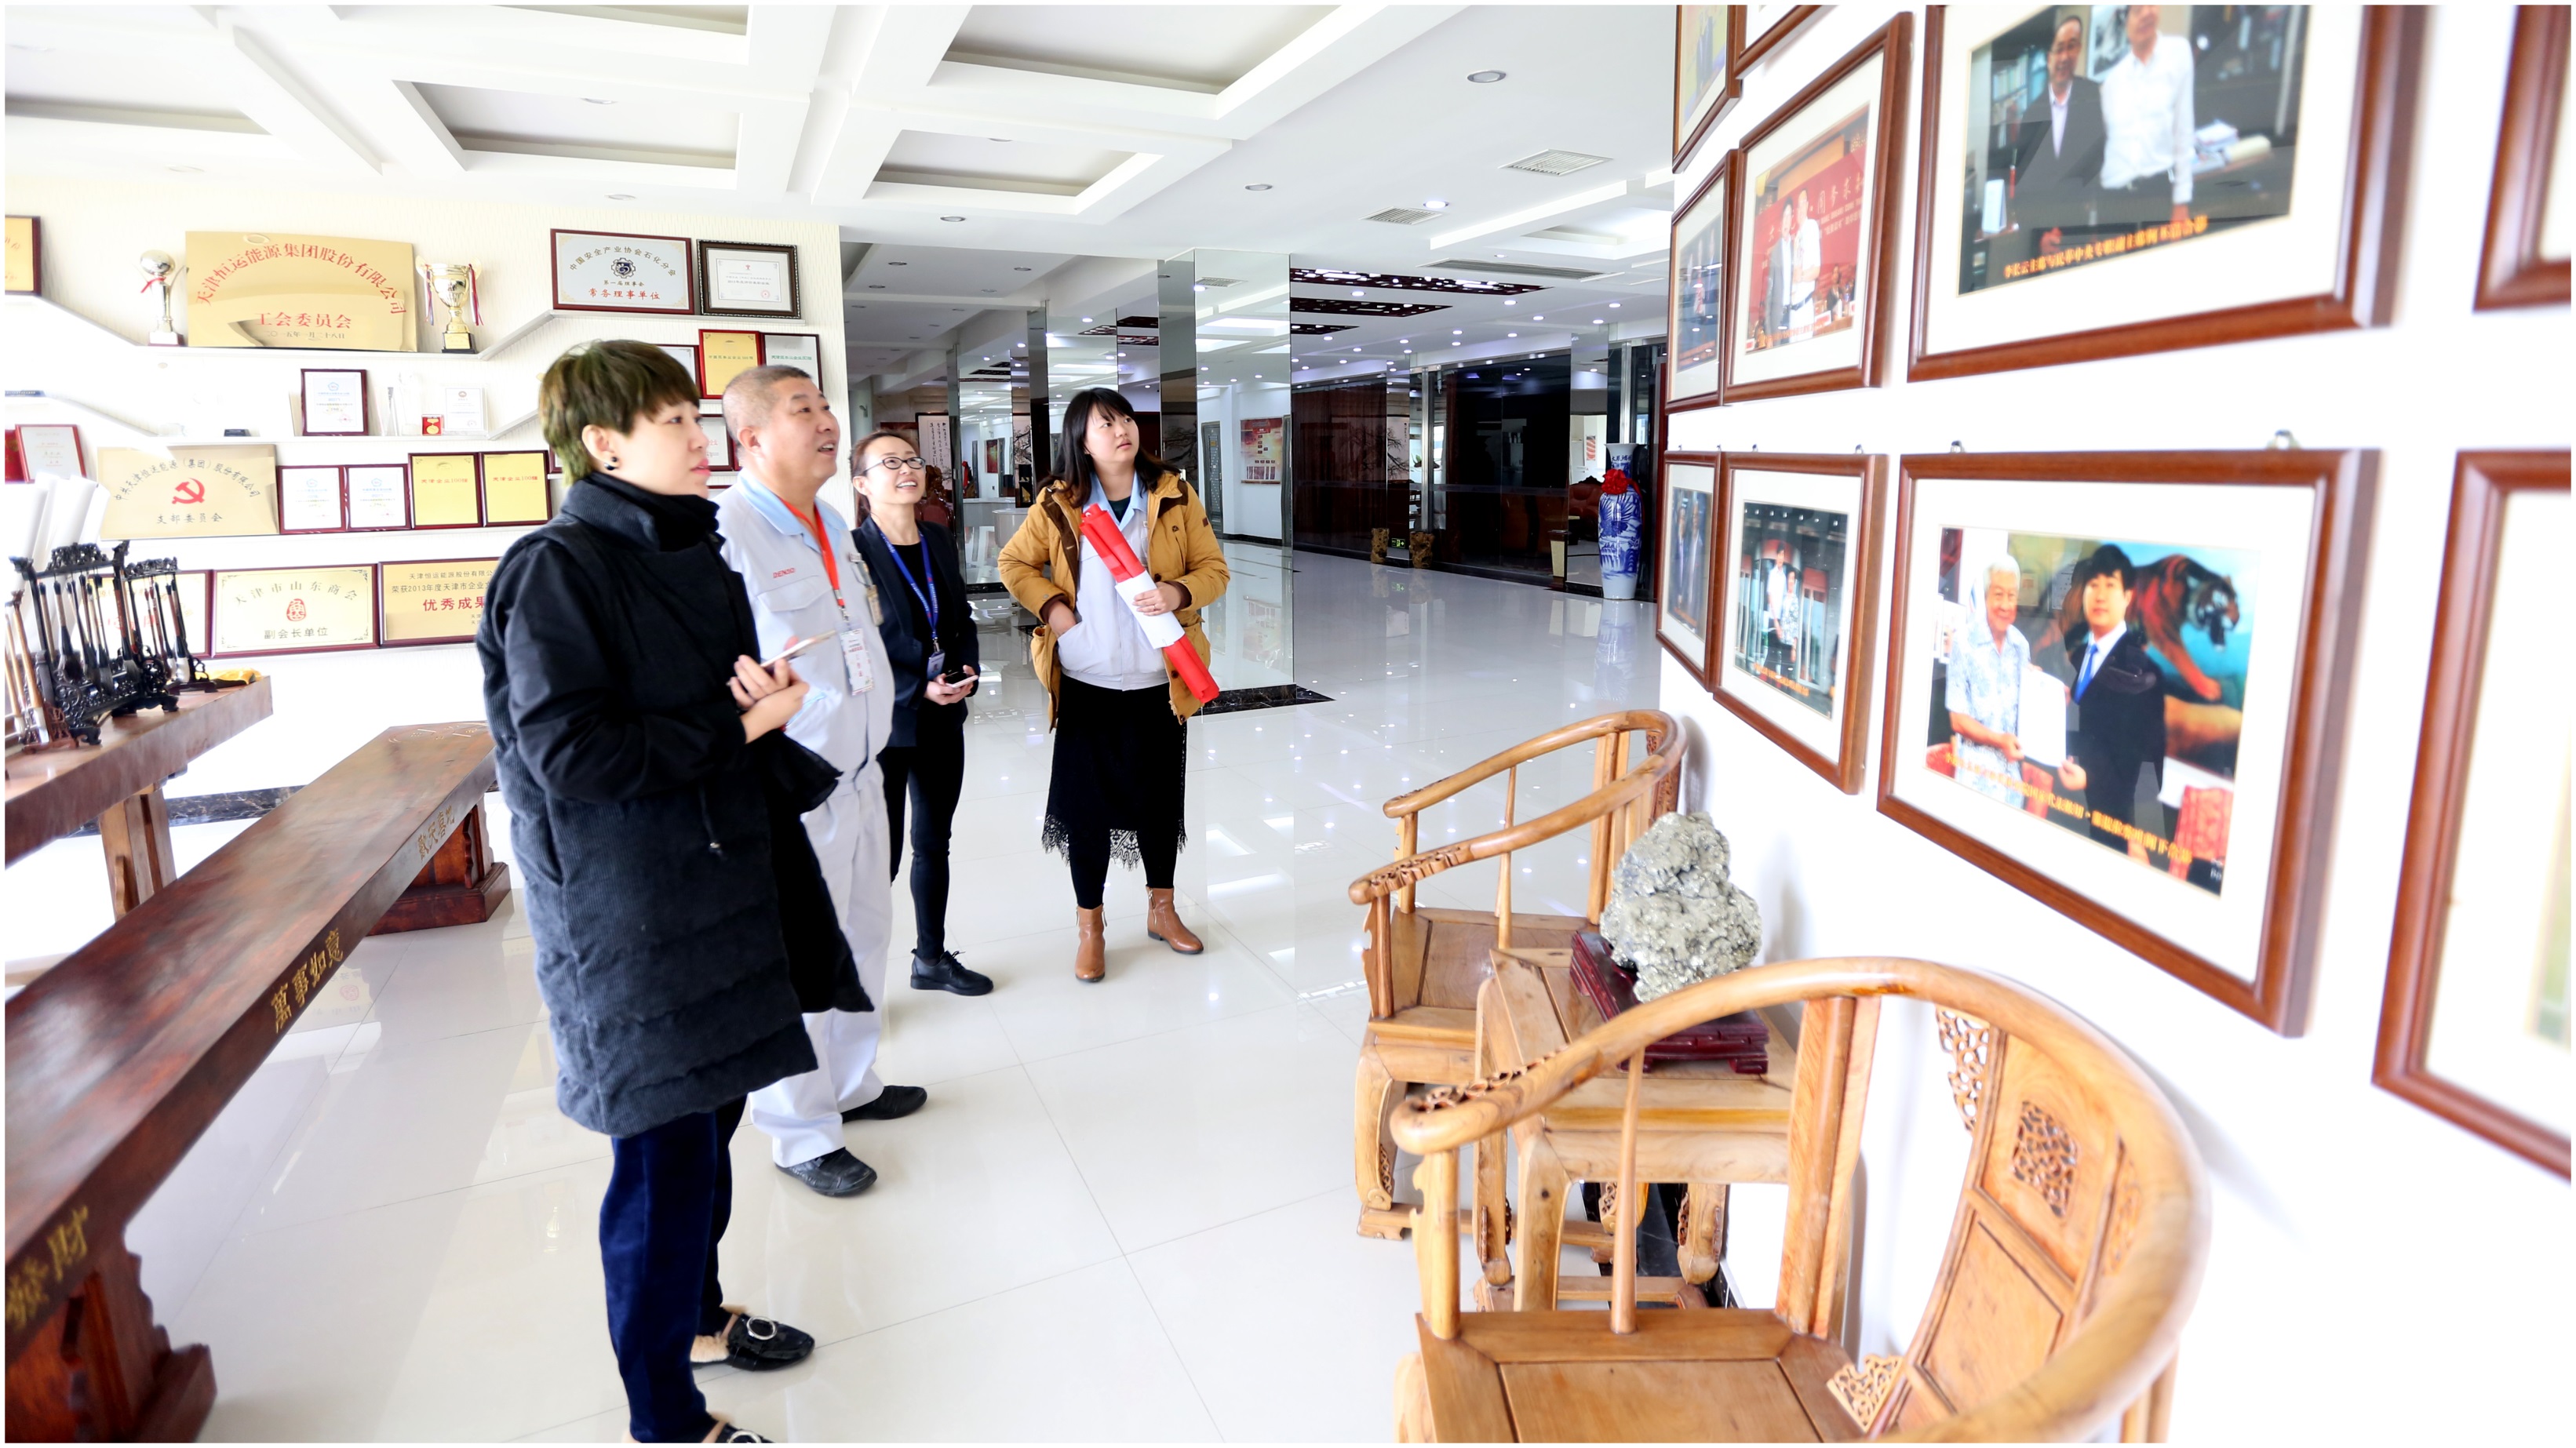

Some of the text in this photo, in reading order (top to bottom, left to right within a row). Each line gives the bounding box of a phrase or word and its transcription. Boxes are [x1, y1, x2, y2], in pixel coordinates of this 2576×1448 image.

[569, 246, 677, 276] 中国安全产业协会石化分会
[196, 242, 407, 315] 天津恒运能源集团股份有限公司
[588, 288, 661, 300] 常务理事单位
[257, 311, 352, 329] 工会委员会
[156, 512, 224, 526] 支部委员会
[234, 580, 359, 606] 天津市山东商会
[263, 626, 330, 641] 副会长单位
